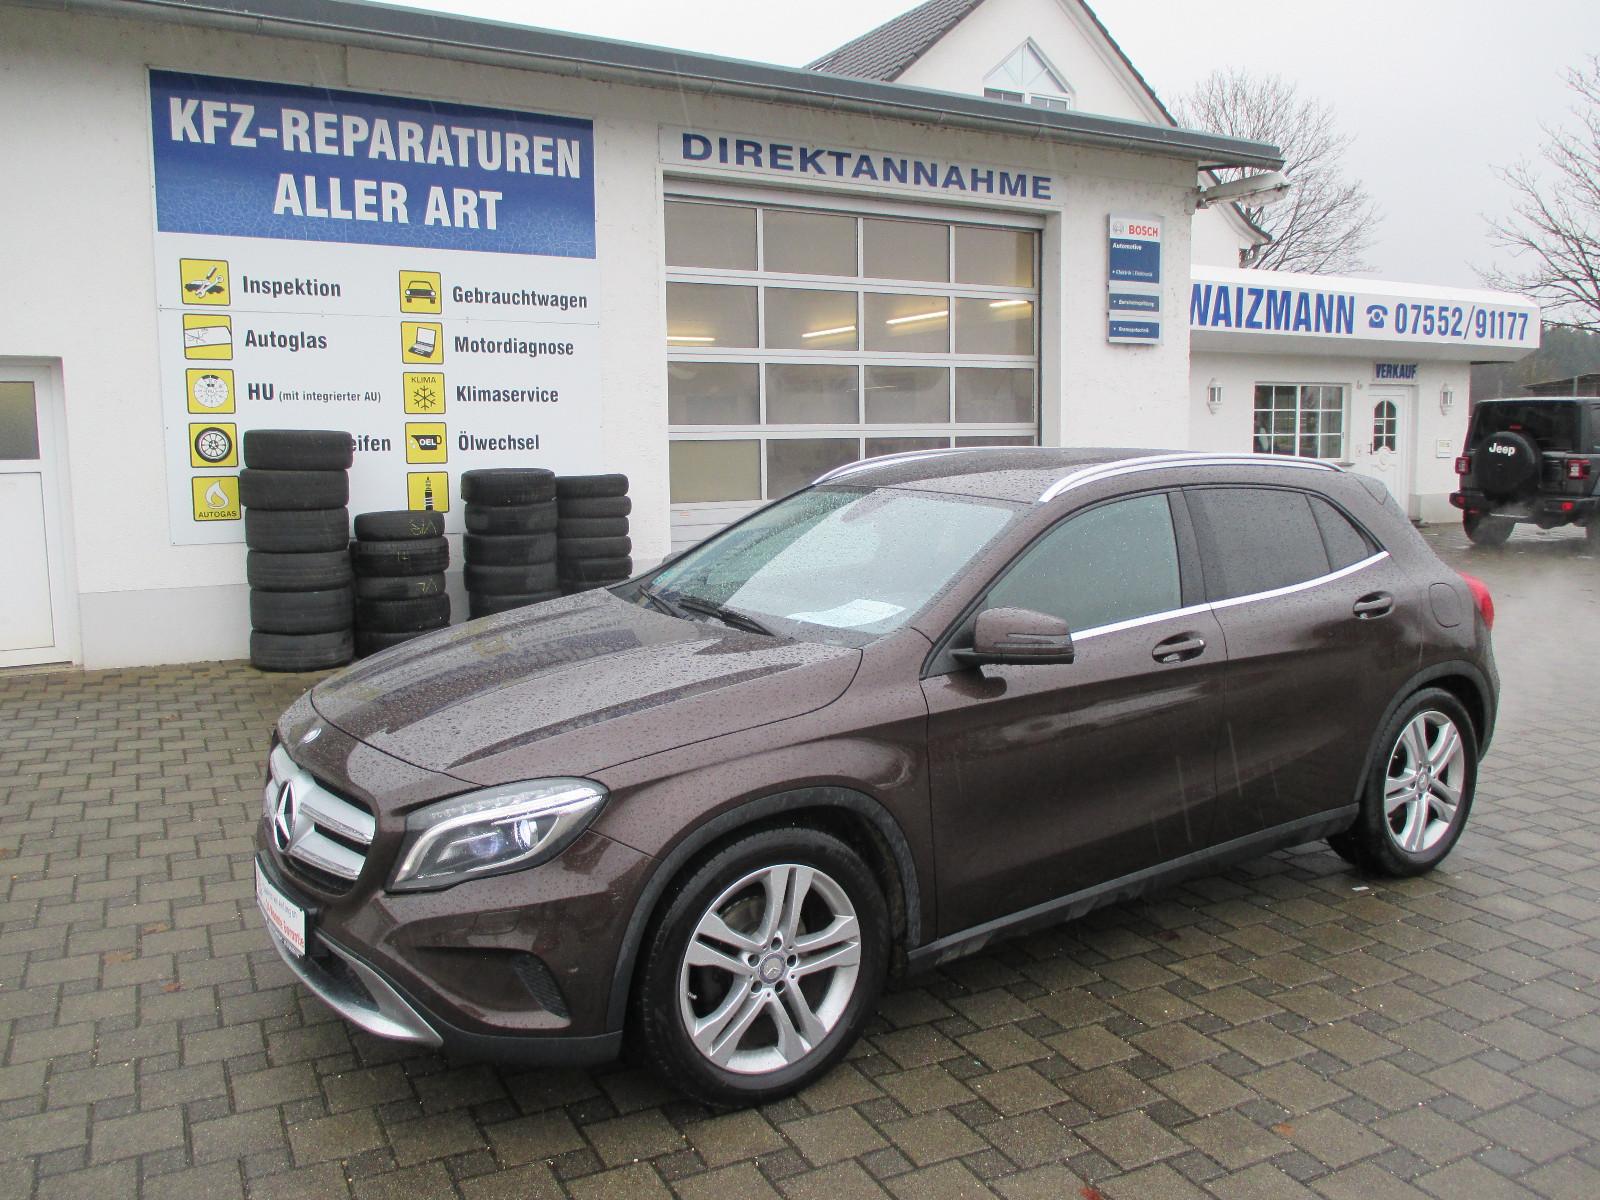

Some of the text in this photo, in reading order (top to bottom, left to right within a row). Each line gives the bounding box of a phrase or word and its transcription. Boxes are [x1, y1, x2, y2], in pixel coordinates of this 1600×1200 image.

[168, 96, 581, 179] KFZ-REPARATUREN
[682, 132, 1052, 201] DIREKTANNAHME
[273, 173, 503, 231] ALLER ART
[1128, 224, 1159, 237] BOSCH
[243, 275, 342, 298] Inspektion
[452, 285, 588, 311] Gebrauchtwagen
[1394, 302, 1529, 342] 07552/91177
[245, 329, 328, 352] Autoglas
[454, 335, 575, 358] Motordiagnose
[411, 376, 437, 384] KLIMA
[1375, 363, 1417, 380] VERKAUF
[247, 382, 381, 404] HU (mit integrierter AU)
[456, 385, 560, 403] Klimaservice
[419, 438, 437, 446] OEL
[458, 430, 541, 451] Ölwechsel
[1488, 442, 1516, 457] Jeep
[198, 510, 238, 519] AUTOGAS
